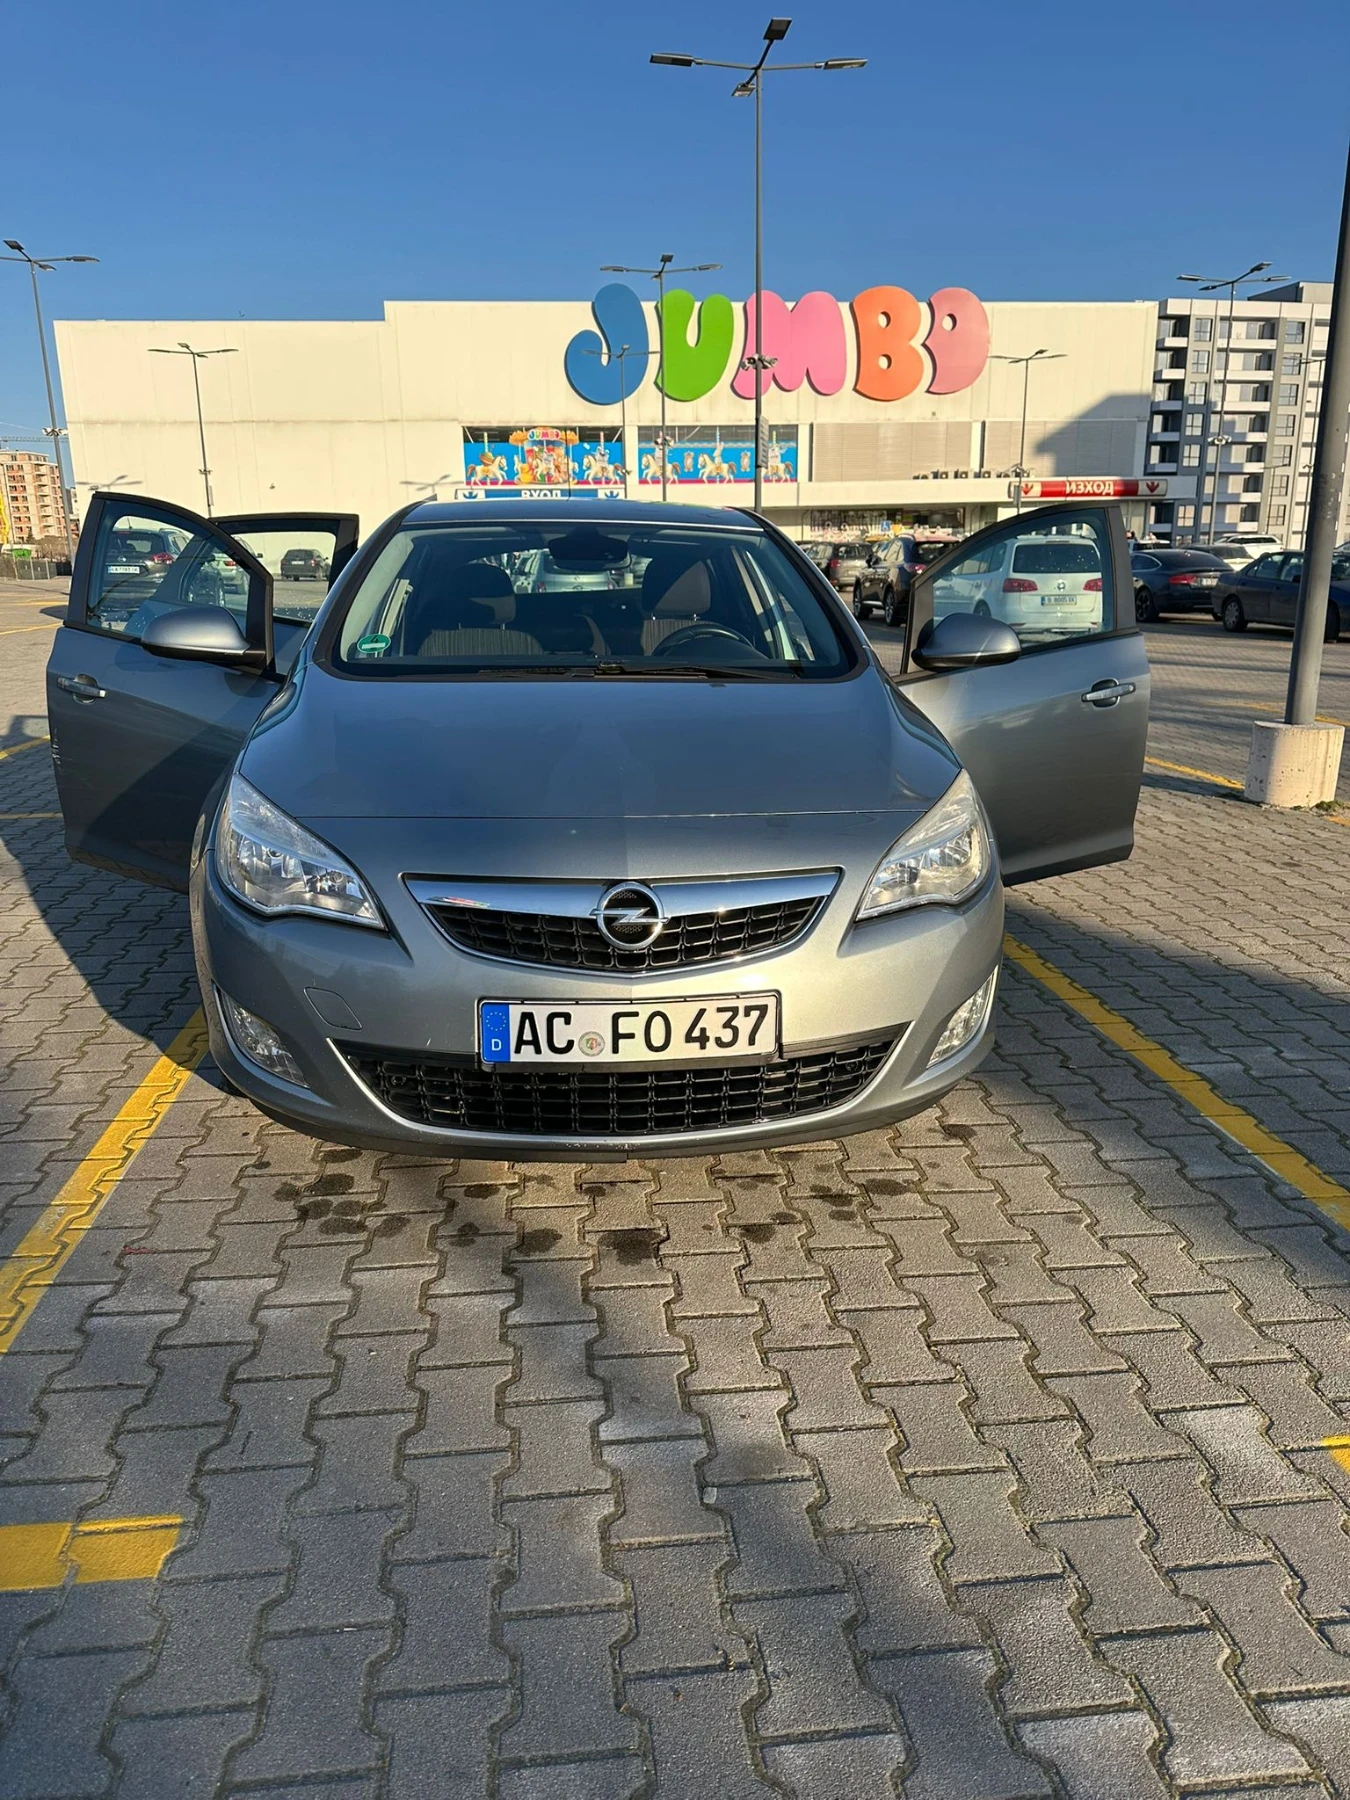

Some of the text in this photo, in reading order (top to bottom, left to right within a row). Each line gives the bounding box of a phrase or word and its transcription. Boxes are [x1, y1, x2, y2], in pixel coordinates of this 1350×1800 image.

[564, 282, 990, 405] JUMBO
[528, 429, 560, 440] JUMBO
[1065, 481, 1114, 495] ИЗХОД
[491, 1039, 502, 1051] D
[514, 1011, 575, 1055] AC
[611, 1010, 672, 1055] FO
[684, 1004, 769, 1050] 437
